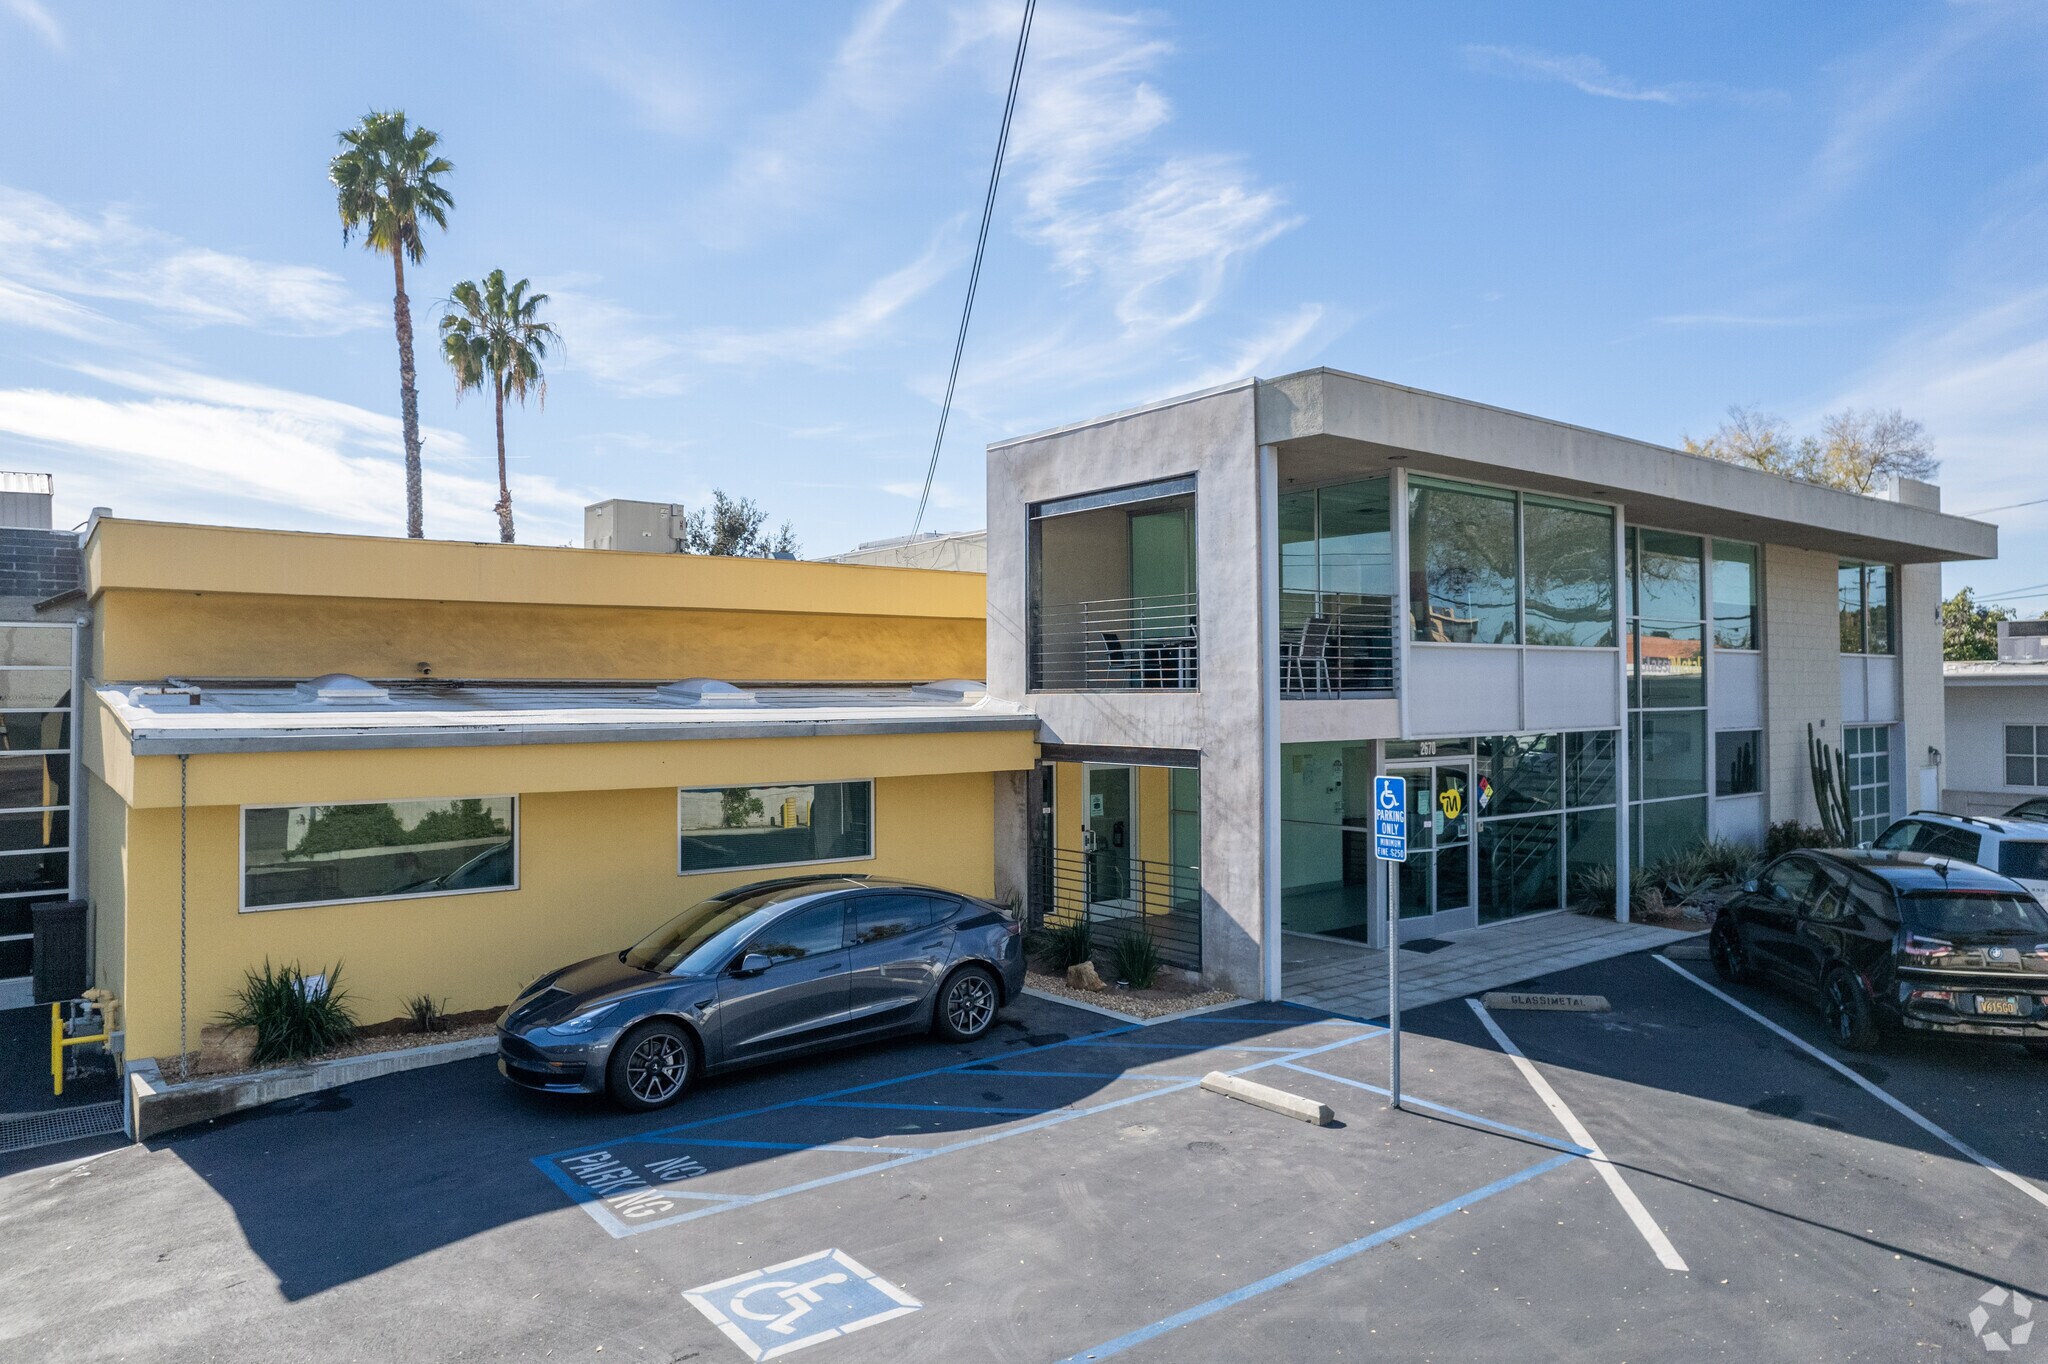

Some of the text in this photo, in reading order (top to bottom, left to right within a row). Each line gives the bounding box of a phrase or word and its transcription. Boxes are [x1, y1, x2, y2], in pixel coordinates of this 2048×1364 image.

[1420, 742, 1436, 756] 2670
[1376, 808, 1404, 823] PARKING
[1381, 822, 1399, 836] ONLY
[1378, 847, 1389, 856] FINE
[645, 1155, 708, 1181] NO
[561, 1150, 675, 1218] PARKING
